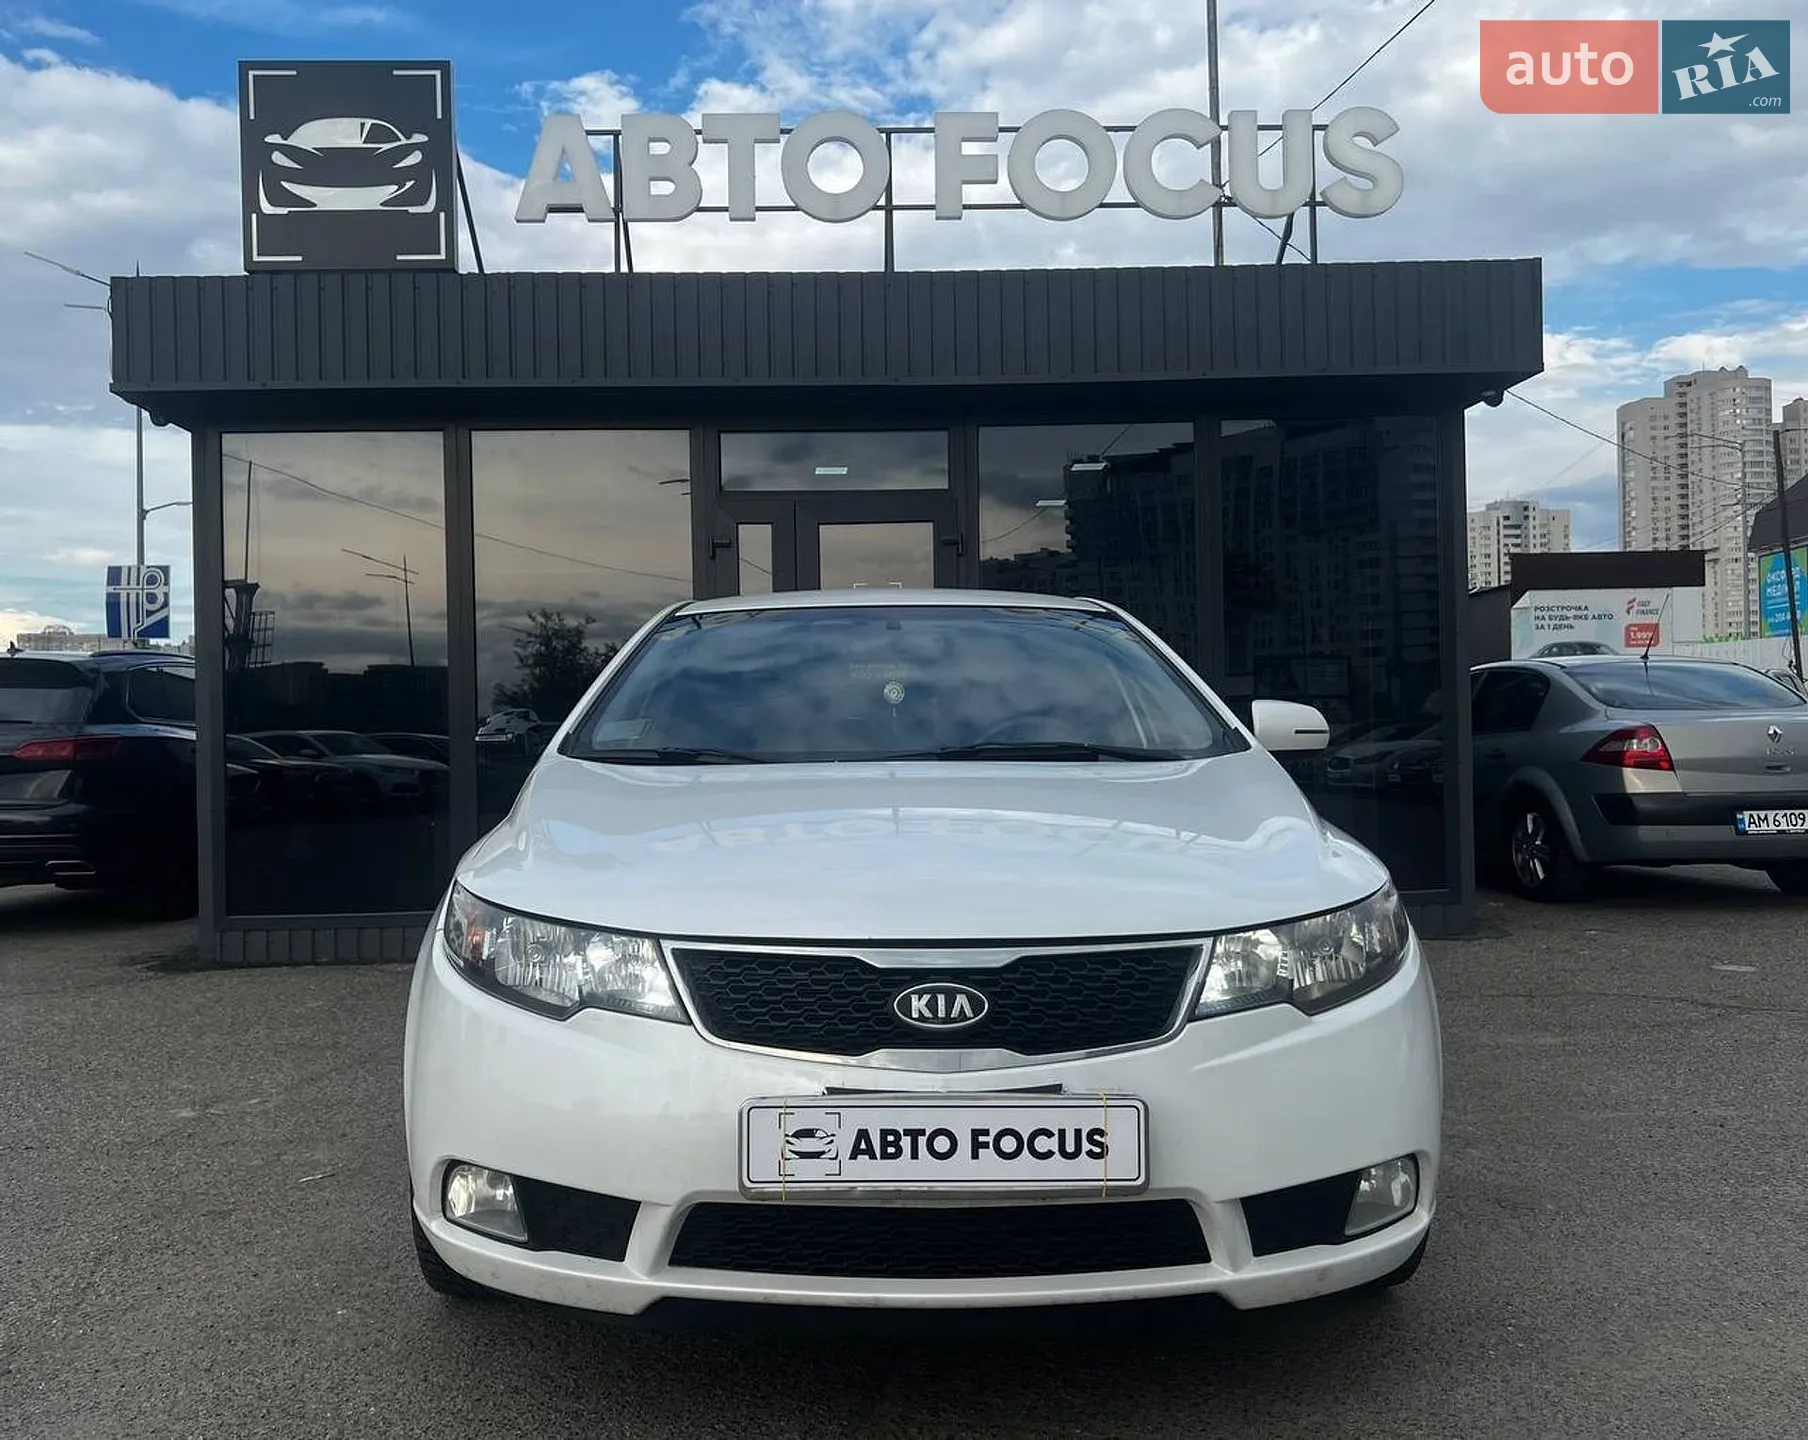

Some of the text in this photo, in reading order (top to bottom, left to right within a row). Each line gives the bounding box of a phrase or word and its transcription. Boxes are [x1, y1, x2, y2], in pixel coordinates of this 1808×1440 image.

[515, 105, 1405, 223] АВТО FOCUS
[1533, 604, 1589, 613] РОЗСТРОЧКА
[1533, 613, 1546, 621] НА
[1590, 612, 1614, 621] АВТО
[1534, 622, 1546, 631] ЗА
[1552, 622, 1575, 632] ДЕНЬ
[1747, 812, 1806, 828] AM 6109
[910, 993, 975, 1019] KIA
[847, 1126, 1110, 1162] АВТО FOCUS
